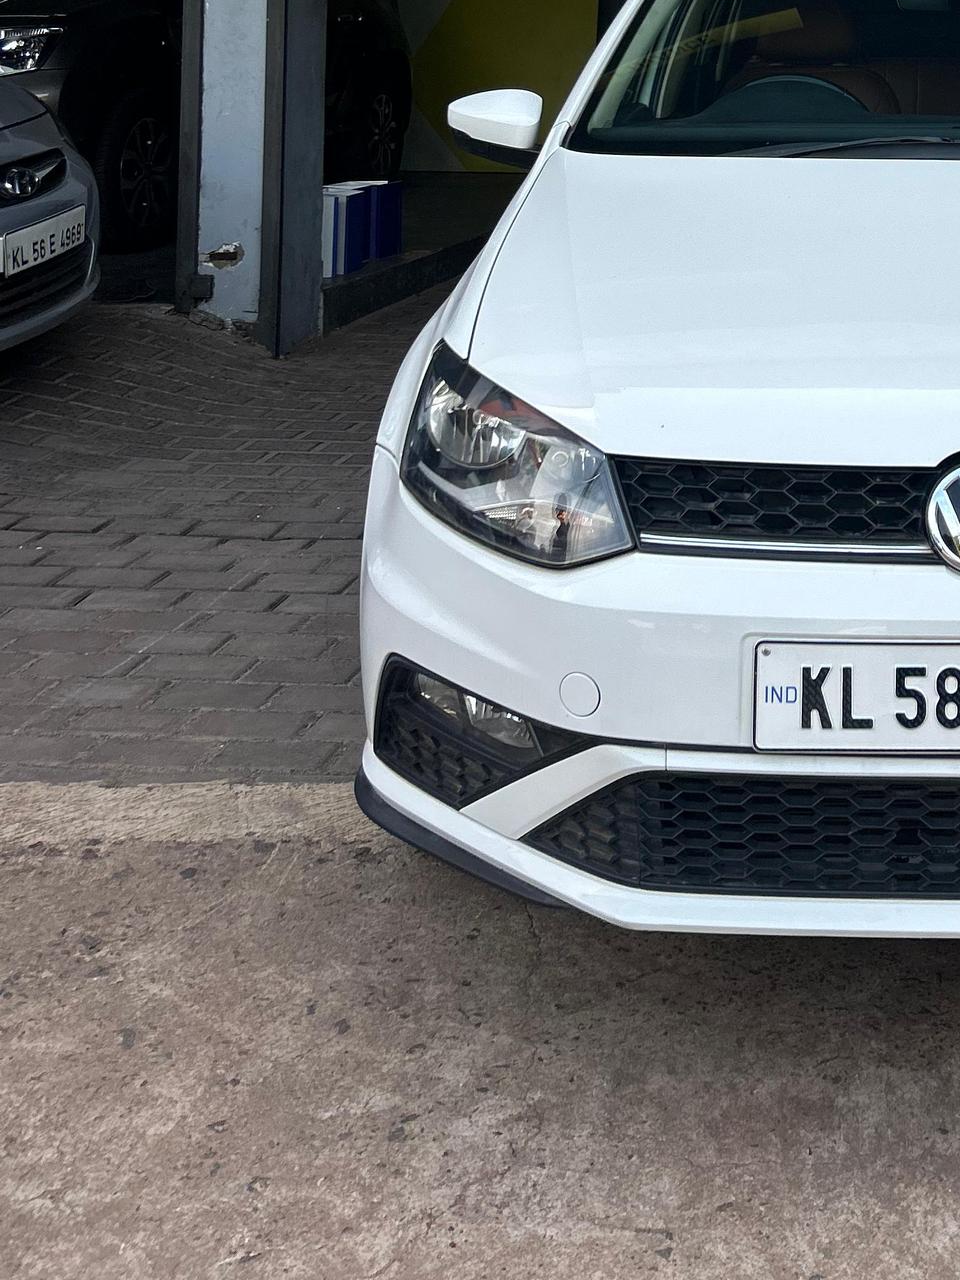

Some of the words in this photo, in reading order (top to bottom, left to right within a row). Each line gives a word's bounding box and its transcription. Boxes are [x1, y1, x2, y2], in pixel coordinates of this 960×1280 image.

[12, 246, 29, 270] KL
[32, 238, 46, 262] 56
[49, 233, 56, 255] E
[764, 685, 797, 704] IND
[801, 665, 873, 729] KL
